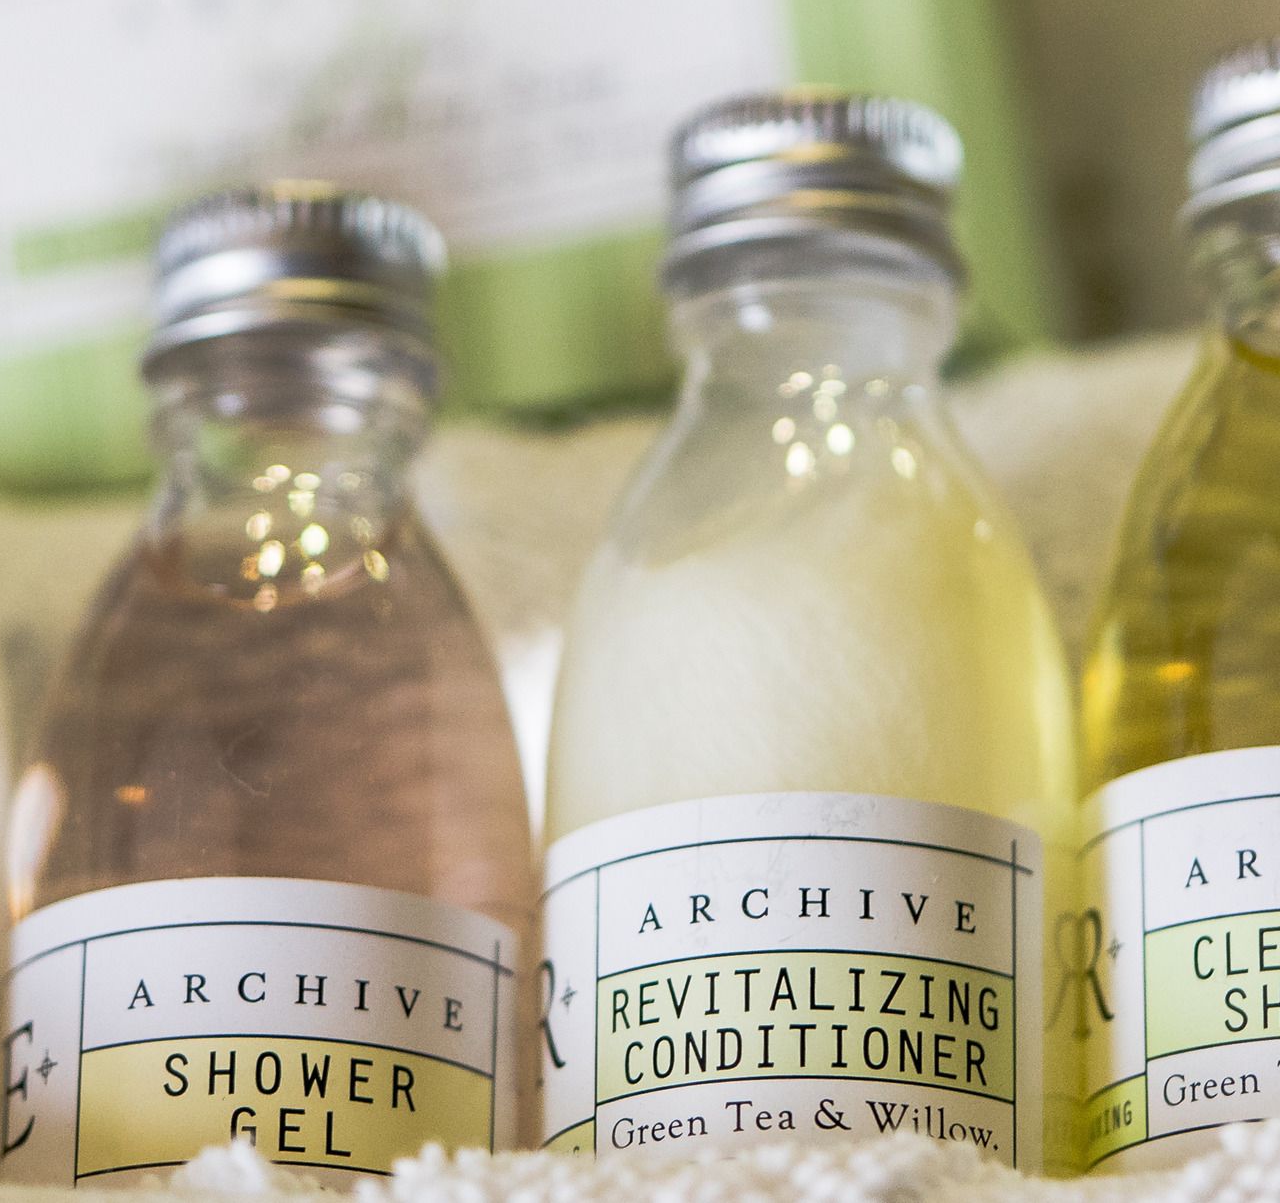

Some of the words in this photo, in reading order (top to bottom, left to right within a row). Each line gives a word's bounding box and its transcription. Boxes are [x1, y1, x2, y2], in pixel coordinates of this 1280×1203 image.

[638, 887, 976, 935] ARCHIVE
[127, 971, 463, 1032] ARCHIVE
[611, 966, 999, 1034] REVITALIZING
[163, 1049, 417, 1112] SHOWER
[624, 1023, 987, 1086] CONDITIONER
[1, 1022, 36, 1158] E
[1163, 1073, 1261, 1107] Green
[230, 1106, 352, 1157] GEL
[611, 1116, 709, 1150] Green
[725, 1100, 796, 1134] Tea
[814, 1098, 851, 1131] &
[866, 1100, 1000, 1152] Willow.
